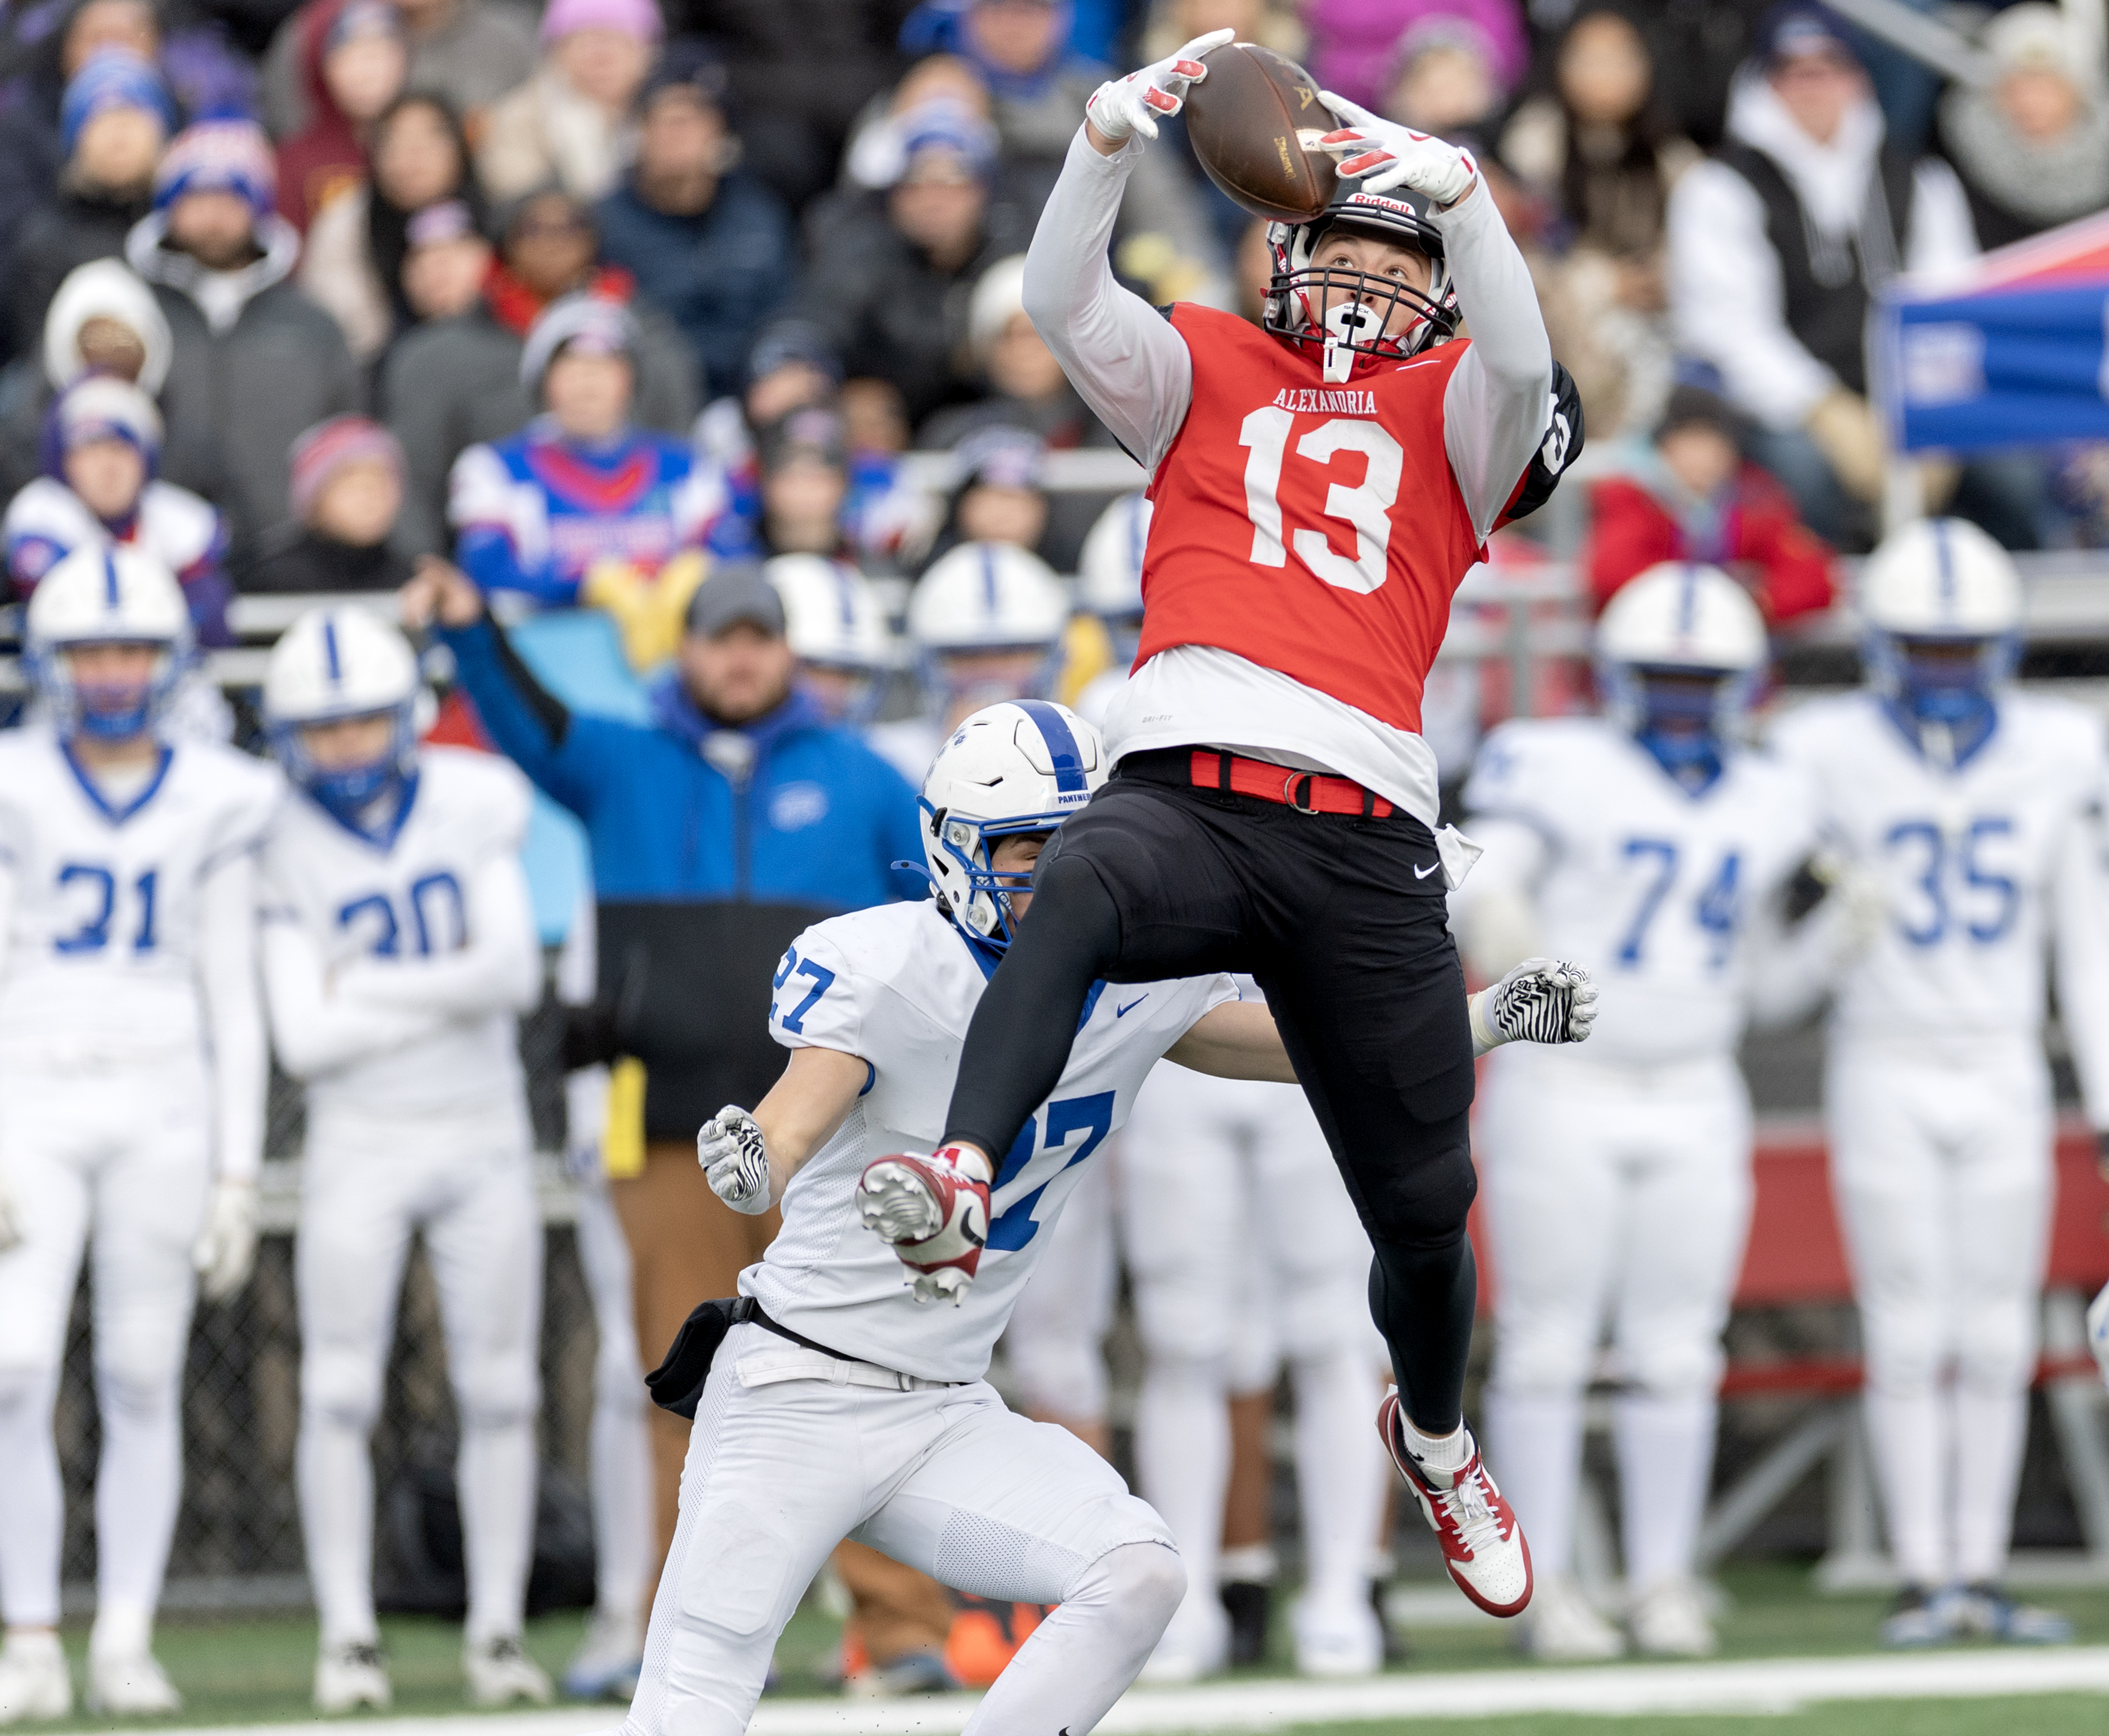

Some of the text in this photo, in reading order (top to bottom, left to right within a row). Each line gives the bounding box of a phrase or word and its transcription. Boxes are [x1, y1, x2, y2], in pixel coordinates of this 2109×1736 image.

[1344, 305, 1369, 314] SHCK
[1272, 388, 1378, 414] ALEXANDRIA
[1238, 406, 1403, 595] 13
[1142, 715, 1173, 723] DRI-FIT
[1618, 834, 1738, 970] 74
[1883, 814, 2024, 949] 35
